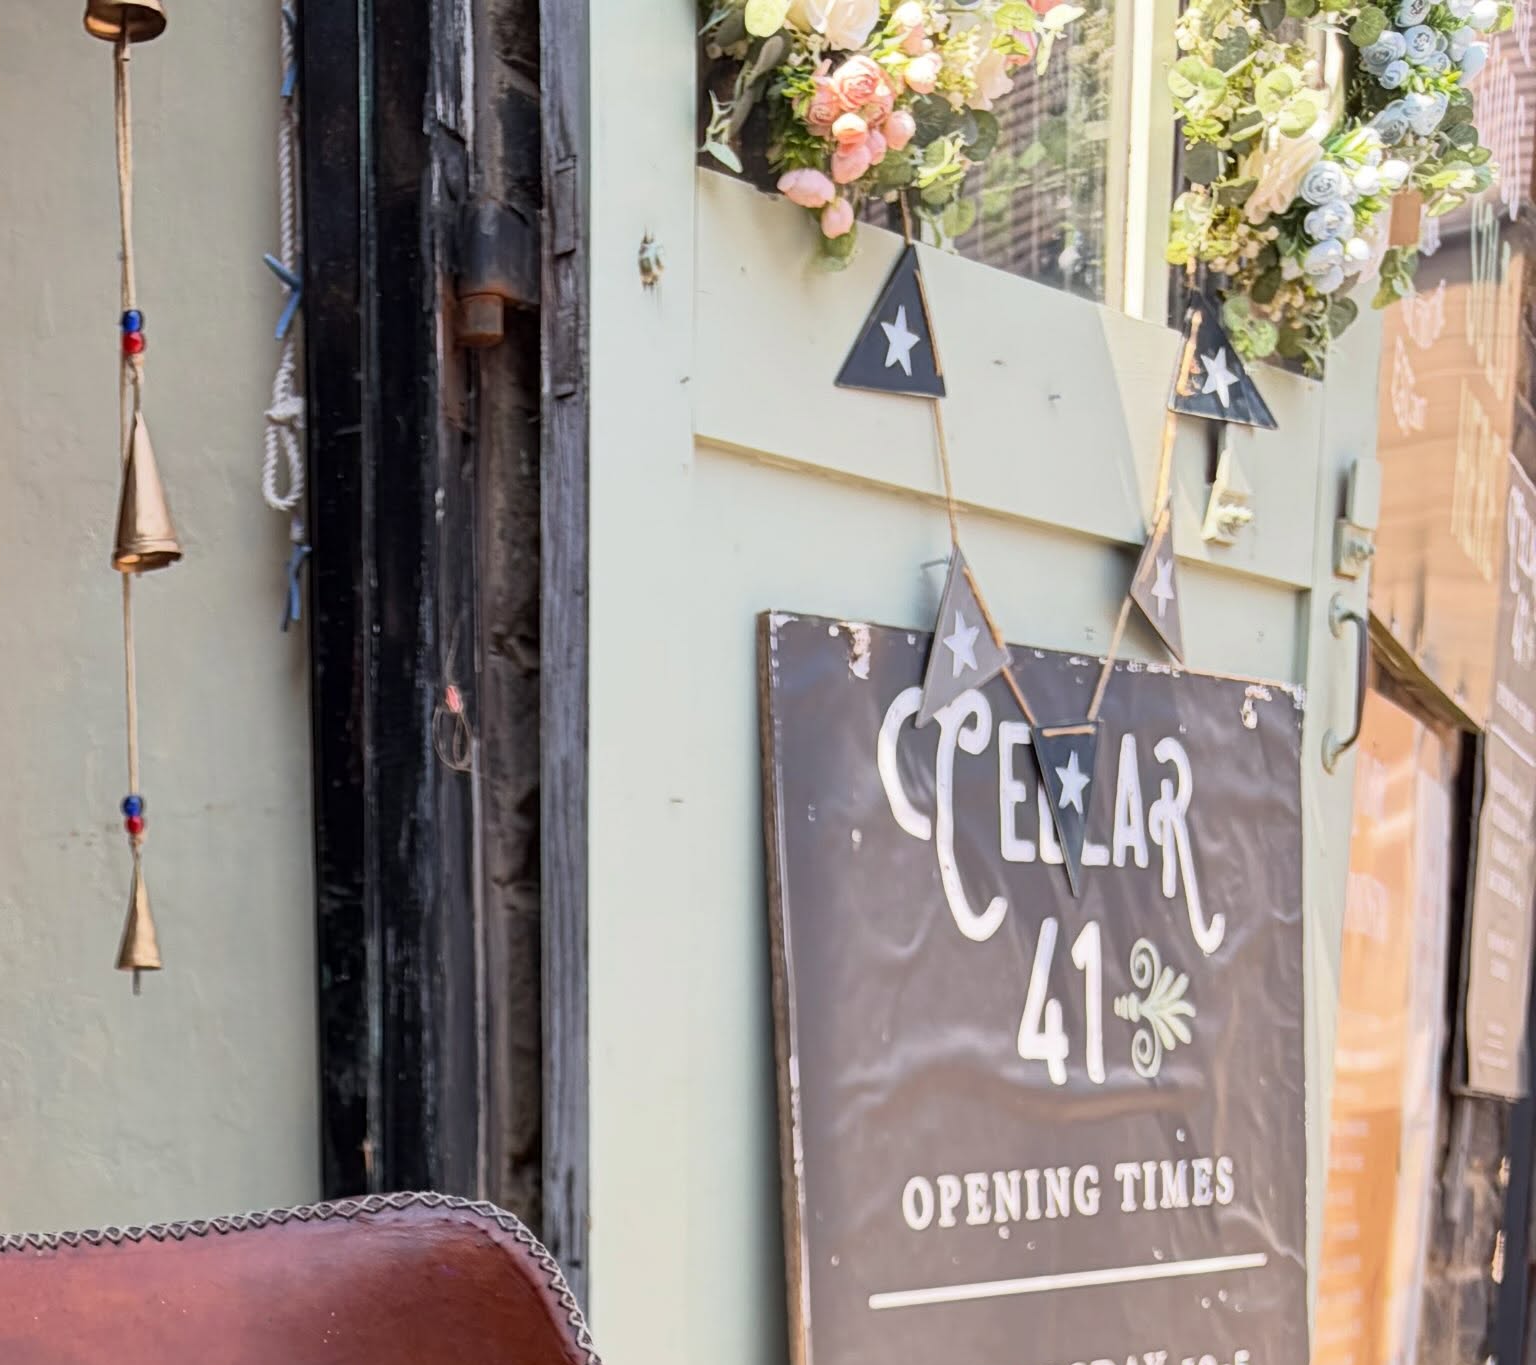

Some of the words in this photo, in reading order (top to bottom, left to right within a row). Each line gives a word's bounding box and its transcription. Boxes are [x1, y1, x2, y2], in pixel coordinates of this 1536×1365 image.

[877, 687, 1226, 956] CEAR
[1017, 917, 1106, 1086] 41
[901, 1164, 1101, 1231] OPENING
[1114, 1156, 1235, 1212] TIMES
